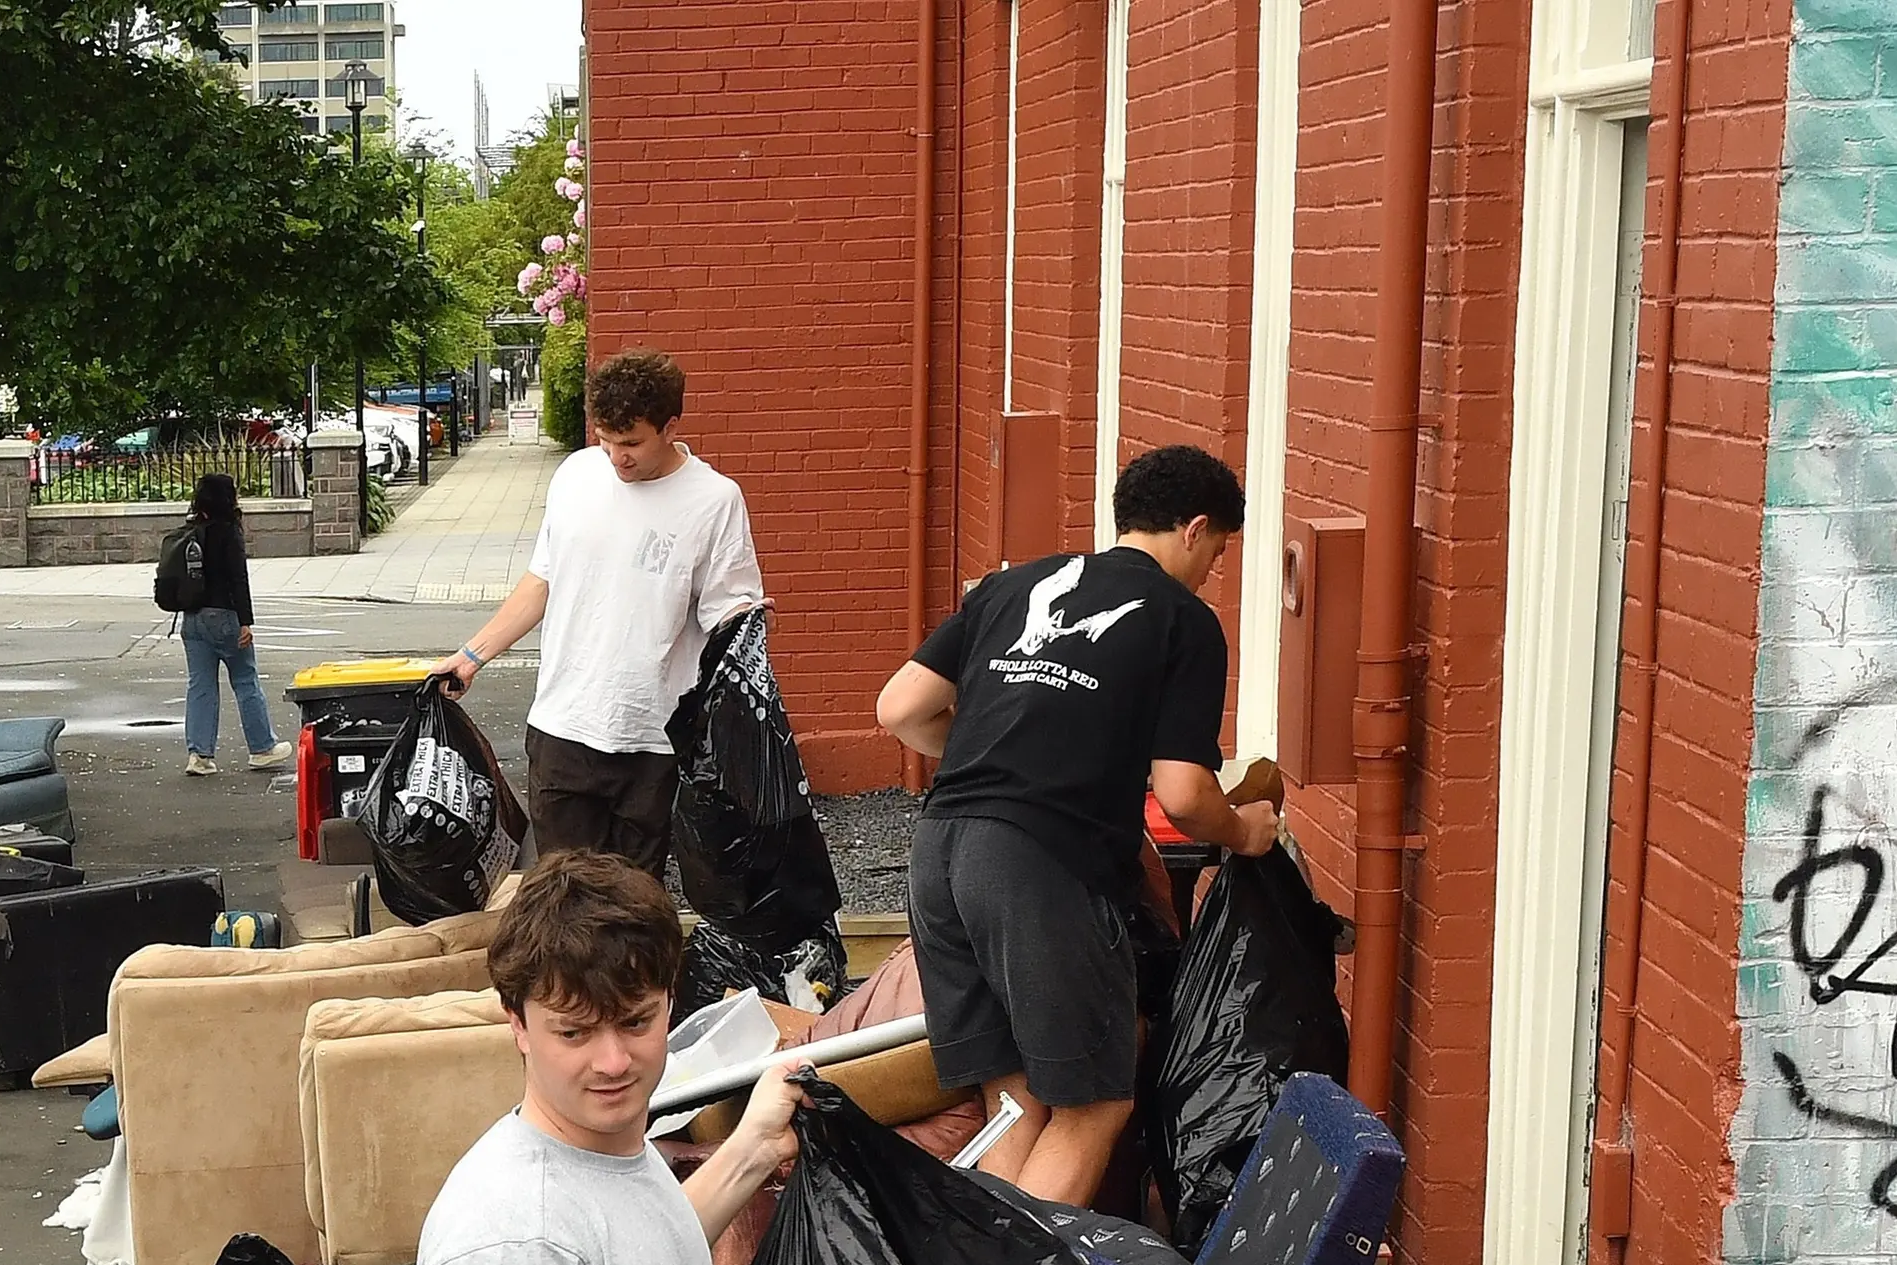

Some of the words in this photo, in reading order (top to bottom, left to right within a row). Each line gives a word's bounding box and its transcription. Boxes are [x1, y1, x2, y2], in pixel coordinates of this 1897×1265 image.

[988, 659, 1030, 673] WHOLE
[1027, 659, 1068, 678] LOTTA
[1068, 669, 1100, 691] RED
[1036, 673, 1070, 691] CARTI
[410, 767, 424, 794] EXTRA
[419, 740, 429, 765] THICK
[440, 750, 453, 778] THICK
[426, 772, 440, 799] EXTRA
[452, 784, 464, 814] EXTRA
